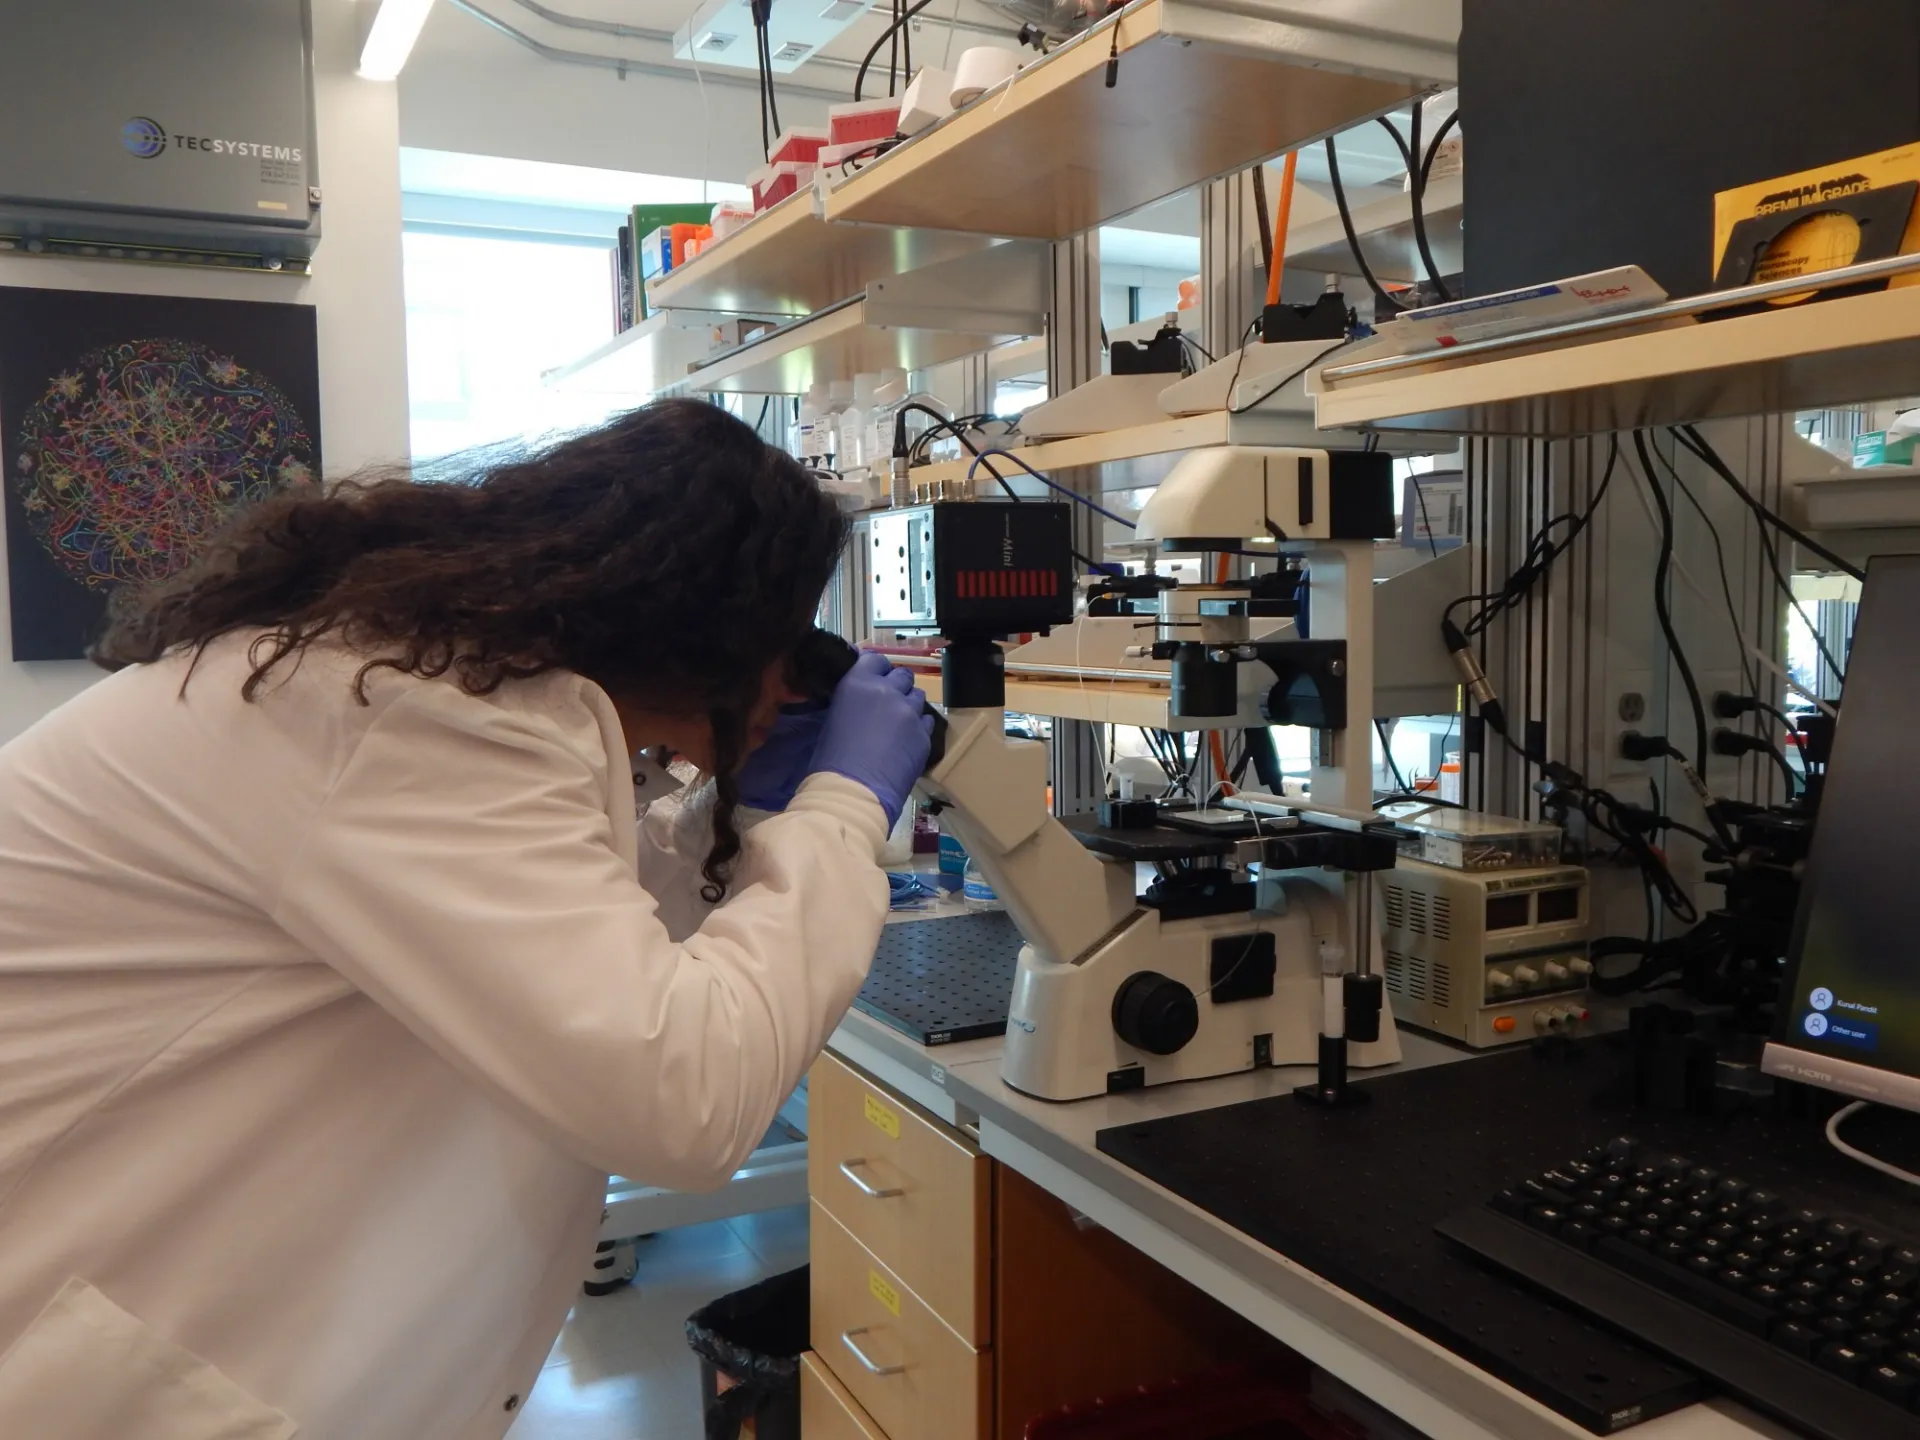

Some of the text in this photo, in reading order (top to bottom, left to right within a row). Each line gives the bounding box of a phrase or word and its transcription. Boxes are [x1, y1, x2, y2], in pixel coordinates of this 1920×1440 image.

[174, 134, 302, 161] TECSYSTEMS
[1755, 179, 1871, 216] PREMIUM GRADE
[1832, 1025, 1851, 1036] Other
